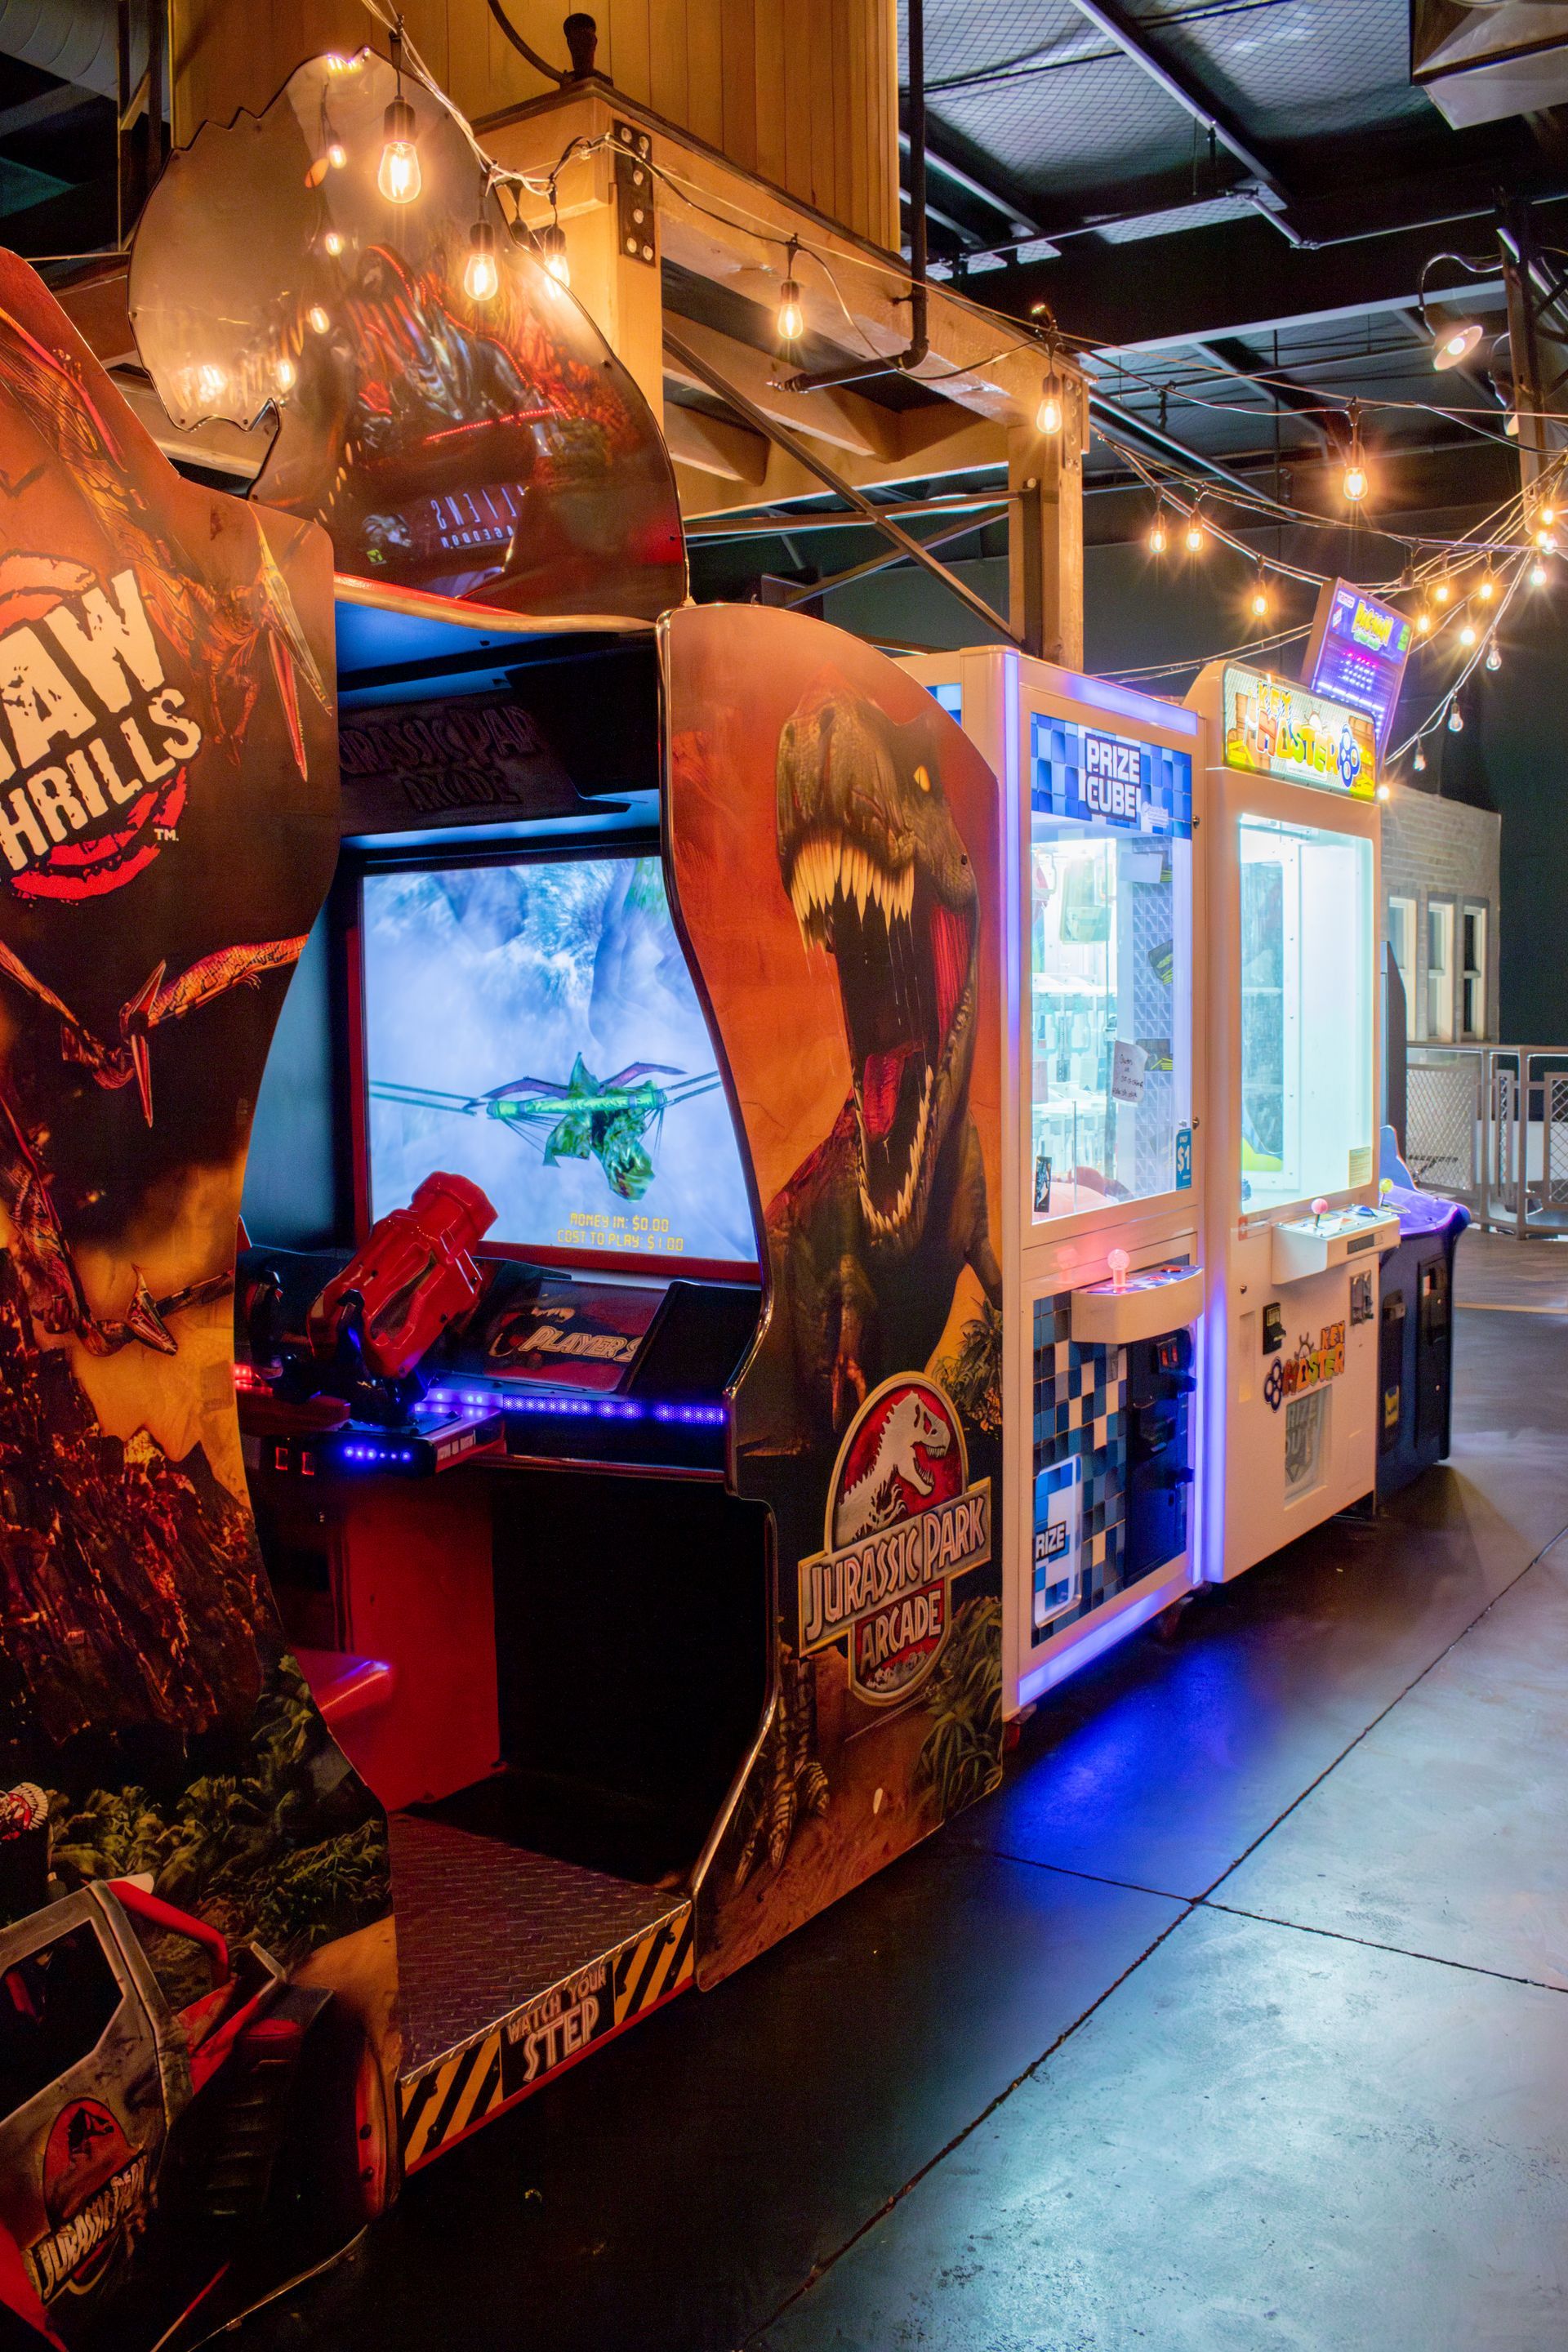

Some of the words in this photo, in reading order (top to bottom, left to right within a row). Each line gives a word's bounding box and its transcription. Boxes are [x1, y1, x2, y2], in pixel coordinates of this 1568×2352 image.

[0, 568, 165, 783] AW
[1257, 680, 1293, 719] KEY
[1085, 737, 1141, 785] PRIZE
[1256, 707, 1339, 775] MASTER
[0, 688, 202, 871] HRILLS
[1086, 775, 1137, 818] CUBE
[1177, 1145, 1191, 1174] $1
[557, 1228, 586, 1244] COST
[590, 1232, 605, 1246] TO
[608, 1233, 644, 1249] PLAY:
[570, 1212, 610, 1228] MONEY
[613, 1215, 629, 1230] IN:
[632, 1214, 669, 1233] $0.00
[518, 1325, 628, 1359] PLAYER
[1321, 1320, 1345, 1351] KEY
[1281, 1342, 1345, 1397] MASTER
[1036, 1524, 1065, 1559] RIZE
[805, 1526, 920, 1642] JURASSIC
[923, 1495, 985, 1583] PARK
[860, 1589, 942, 1675] ARCADE
[507, 1984, 563, 2045] WATCH
[567, 1965, 607, 2007] YOUR
[523, 1995, 600, 2082] STEP
